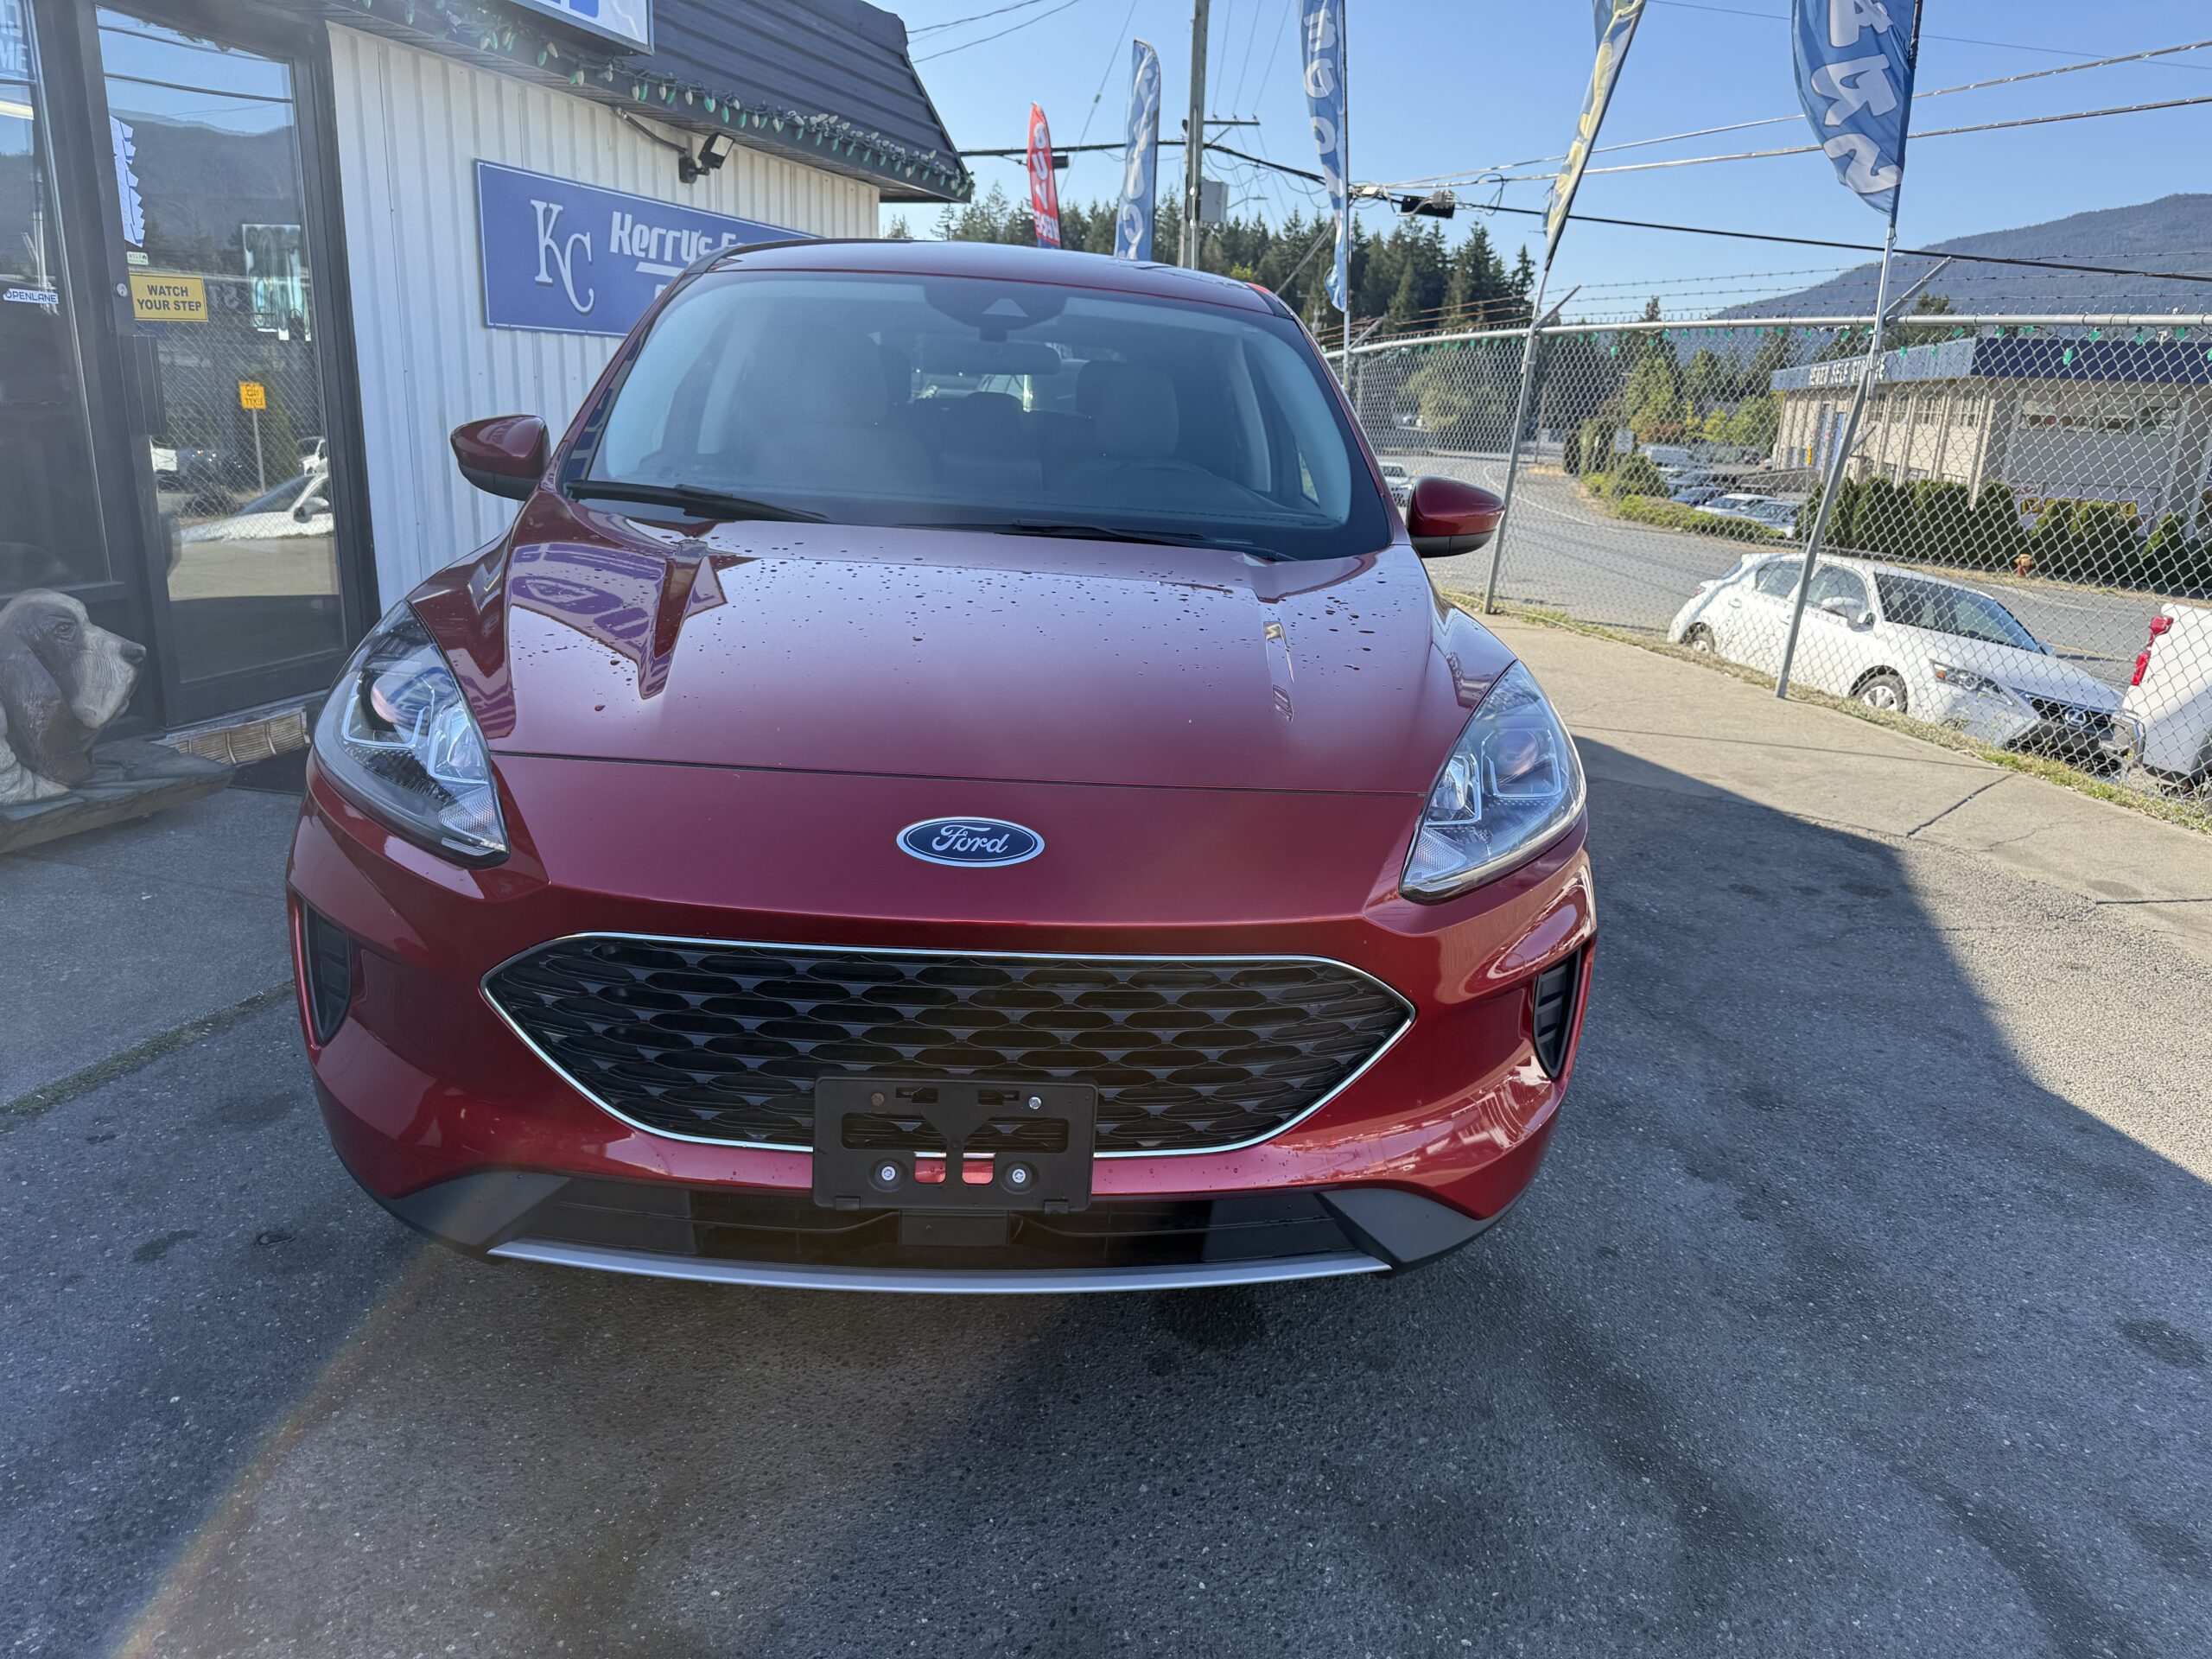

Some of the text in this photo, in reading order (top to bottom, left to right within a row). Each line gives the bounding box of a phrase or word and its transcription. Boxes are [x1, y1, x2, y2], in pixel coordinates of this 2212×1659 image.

[5, 290, 57, 302] OPENLANE
[147, 284, 189, 297] WATCH
[137, 299, 201, 311] YOUR STEP
[931, 824, 1010, 854] Ford
